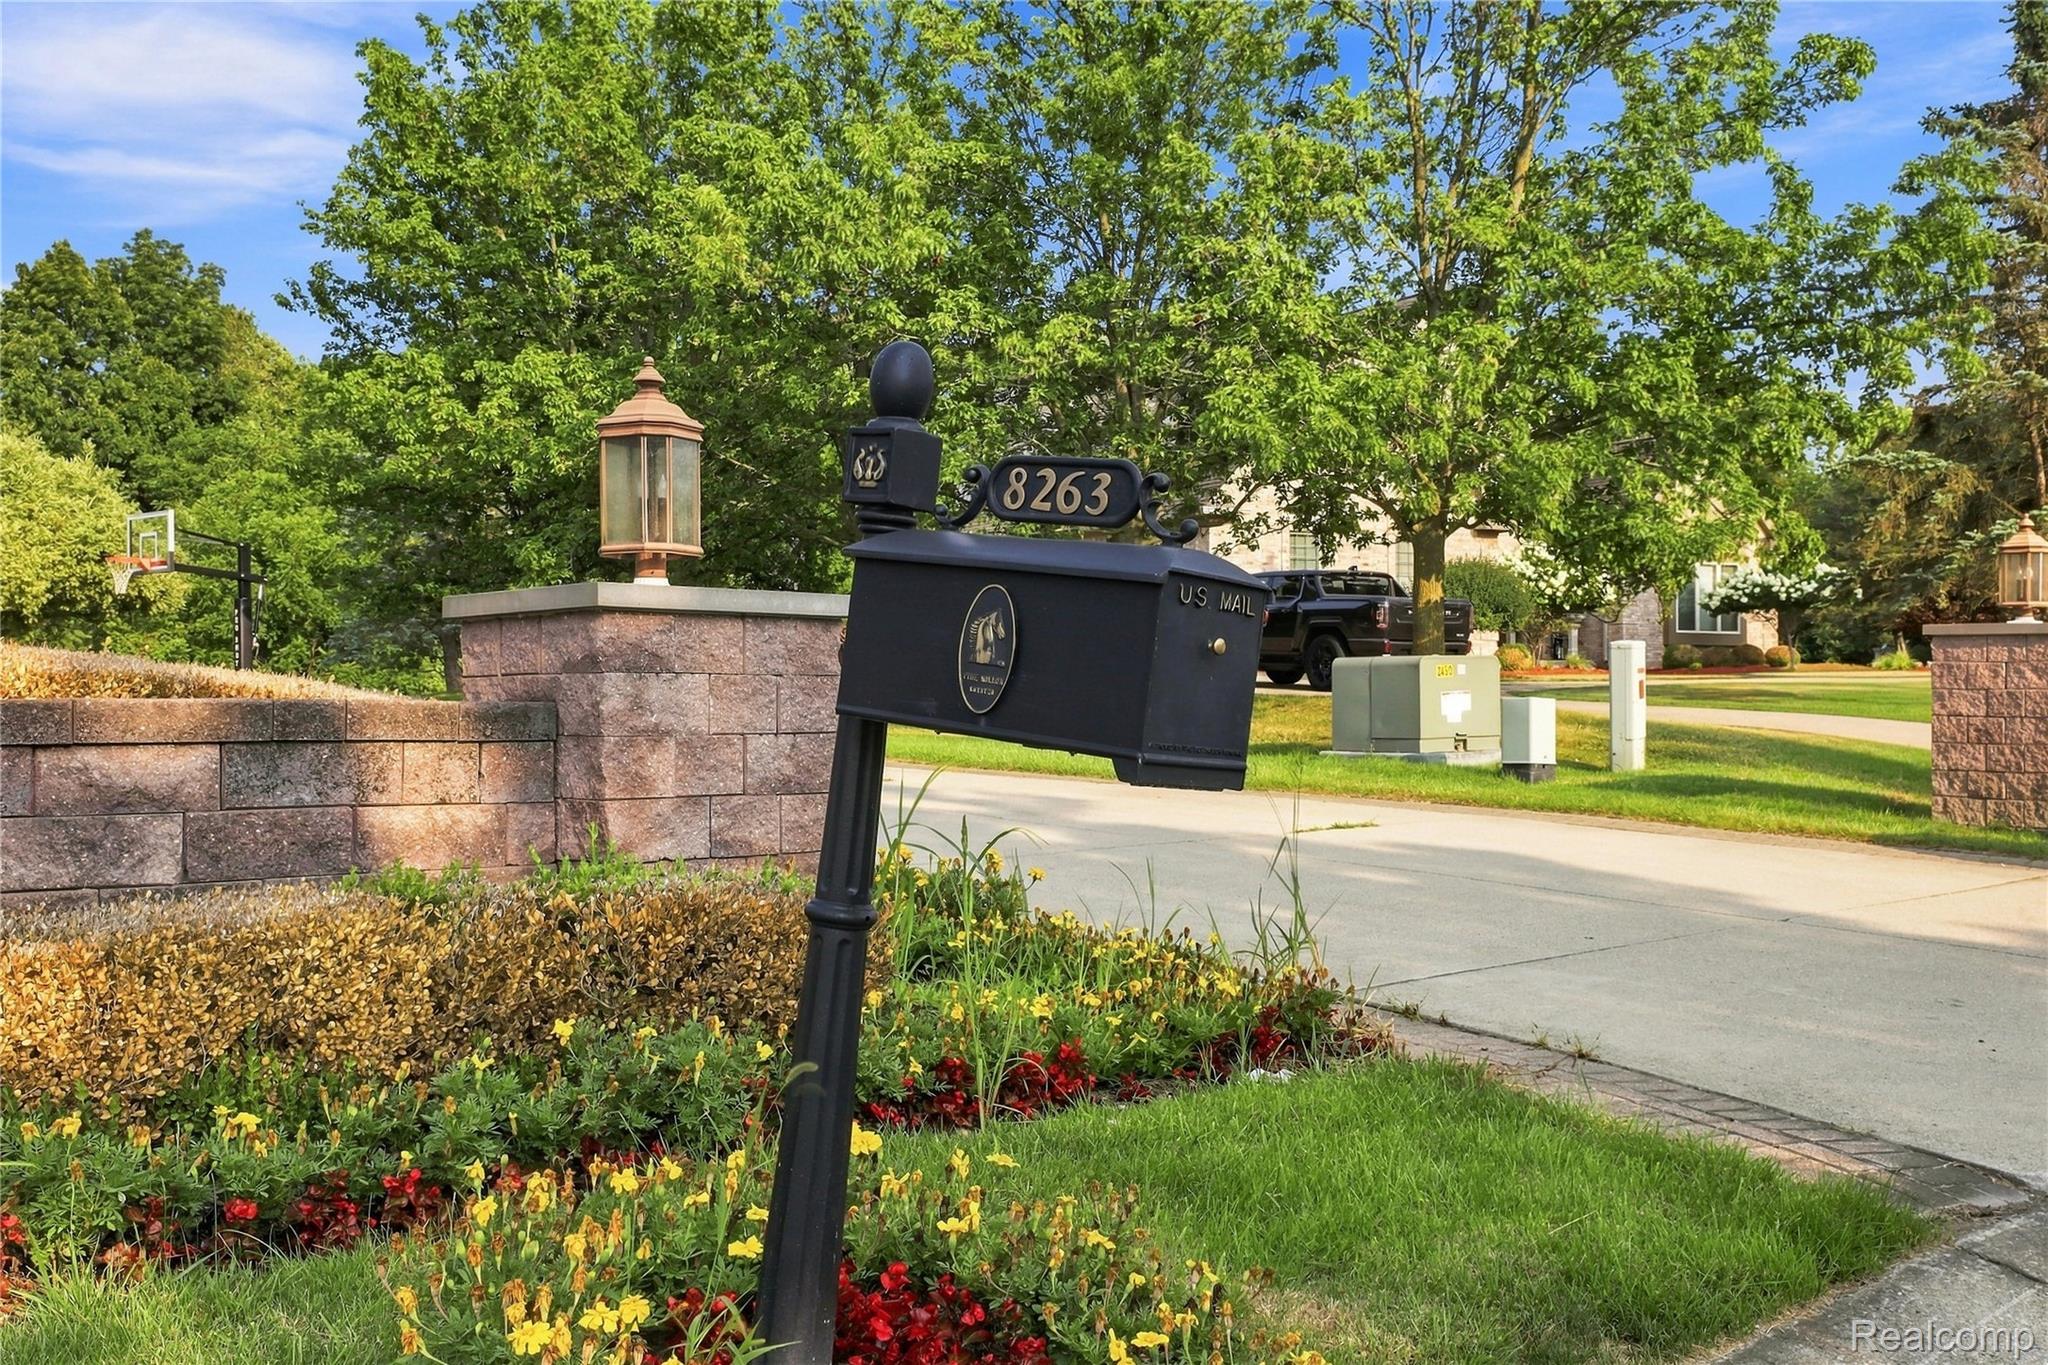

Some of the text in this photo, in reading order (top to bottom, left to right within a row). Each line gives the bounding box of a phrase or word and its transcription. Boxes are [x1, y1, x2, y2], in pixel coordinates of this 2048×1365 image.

[1003, 467, 1112, 516] 8263
[1180, 583, 1256, 617] US MAIL
